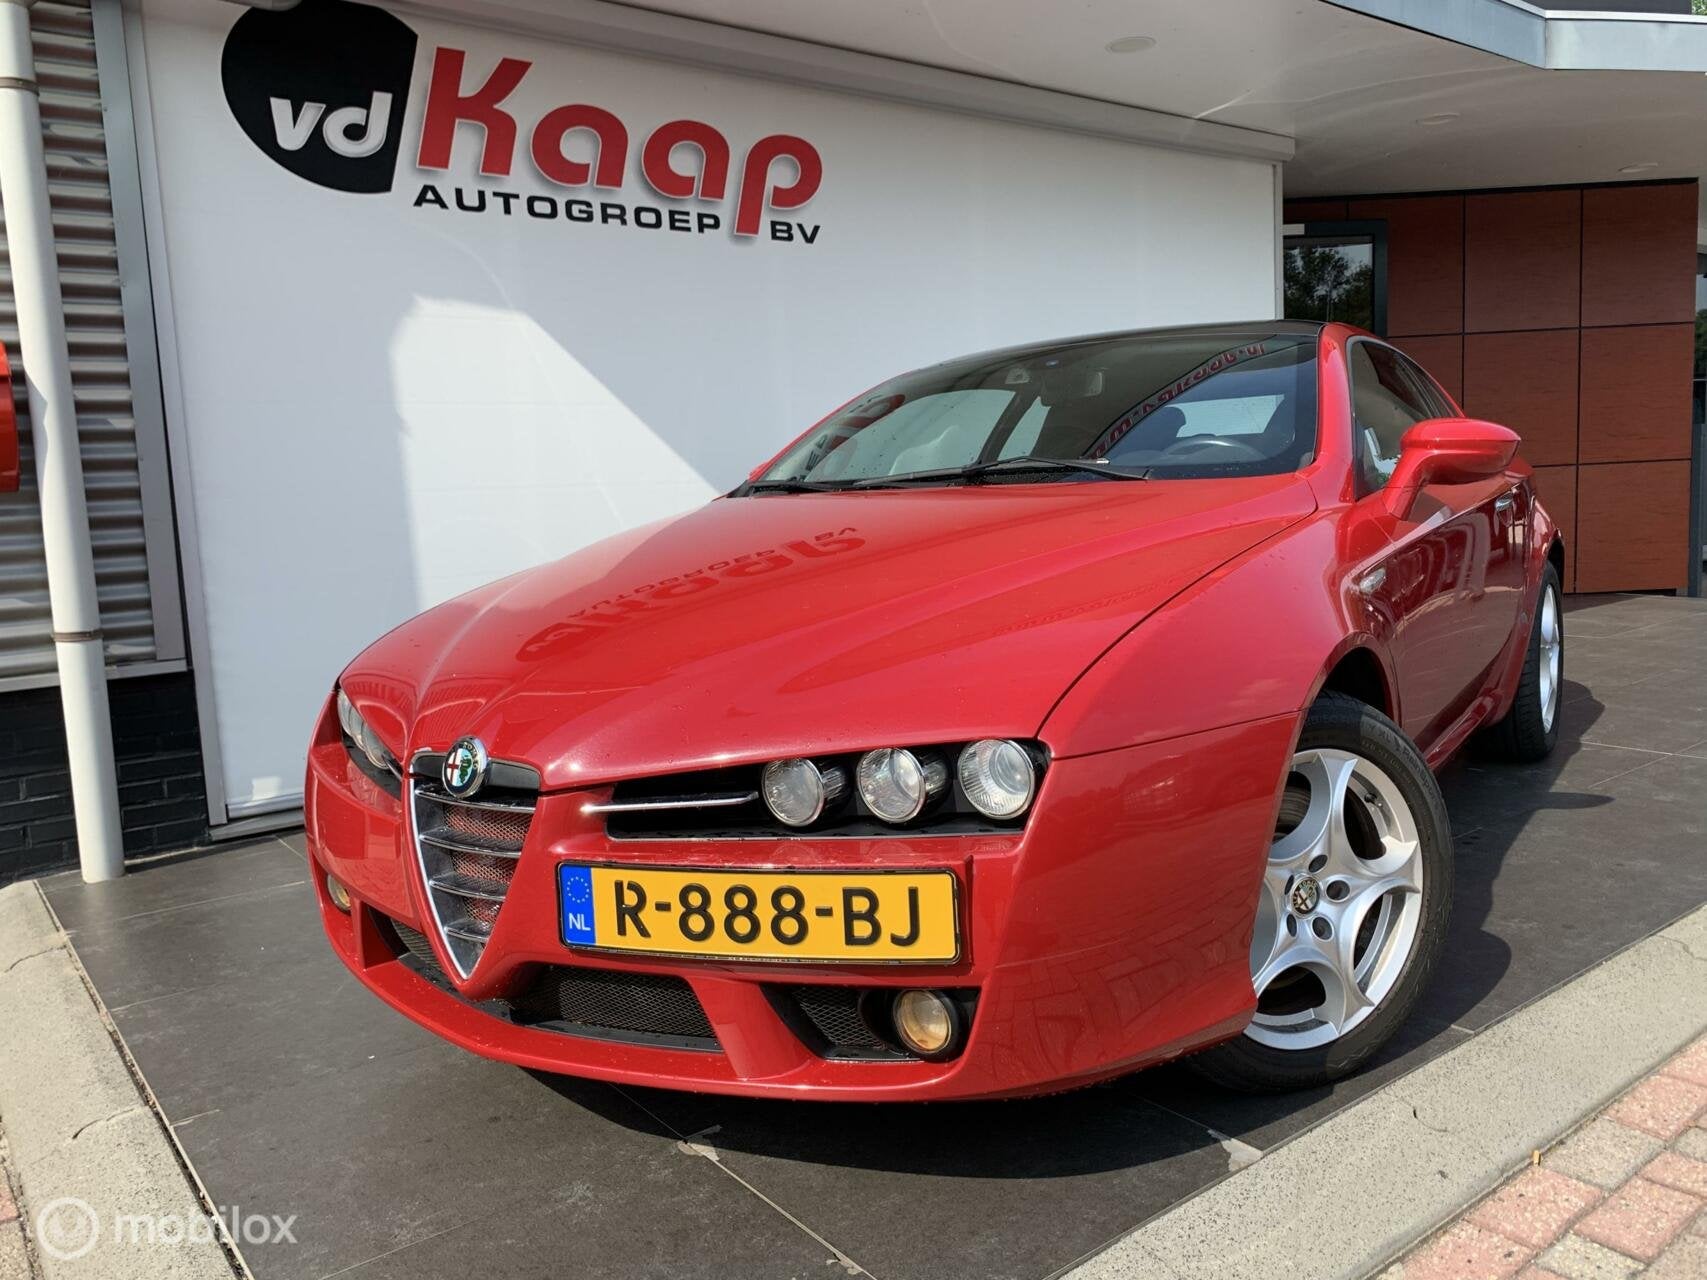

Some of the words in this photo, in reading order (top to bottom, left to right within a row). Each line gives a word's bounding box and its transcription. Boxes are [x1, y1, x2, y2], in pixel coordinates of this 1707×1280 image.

[269, 90, 393, 158] vd
[416, 46, 824, 237] Kaap
[413, 184, 721, 234] AUTOGROEP
[770, 220, 821, 245] BV
[569, 912, 591, 930] NL
[613, 879, 922, 947] R-888-BJ
